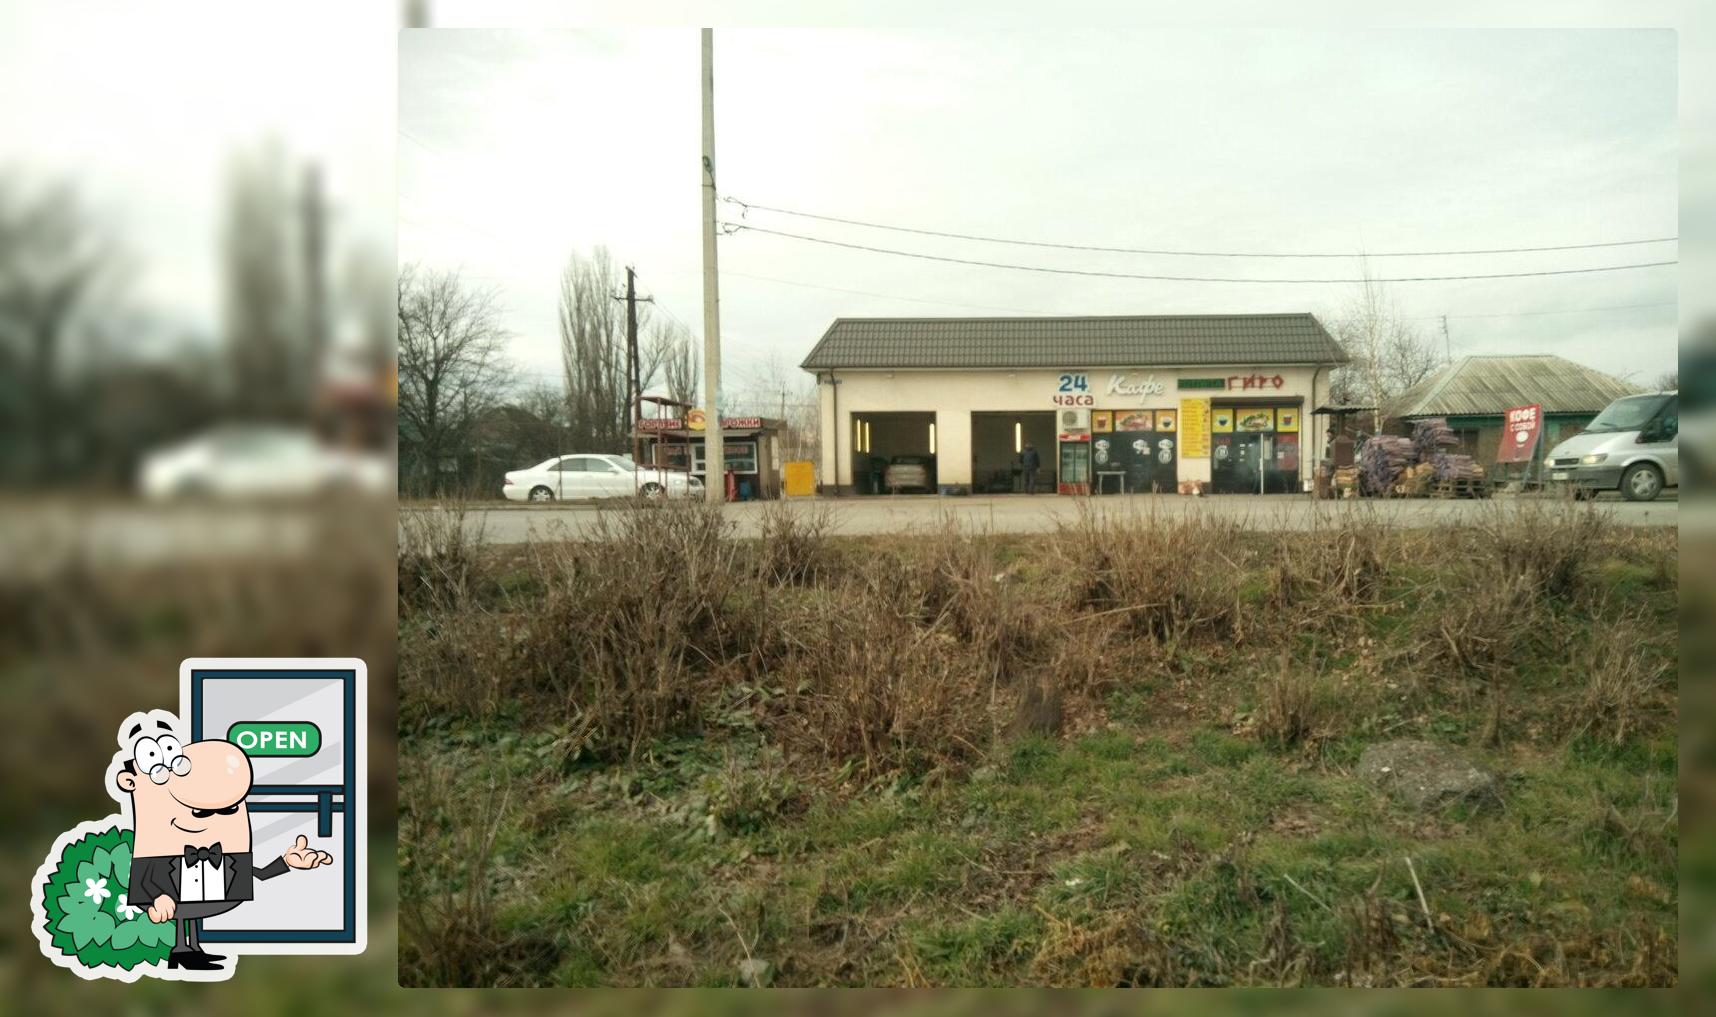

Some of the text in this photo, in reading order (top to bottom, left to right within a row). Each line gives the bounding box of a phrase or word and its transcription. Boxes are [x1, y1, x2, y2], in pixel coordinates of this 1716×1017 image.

[1058, 374, 1088, 392] 24
[1107, 373, 1165, 404] Кафе
[1053, 395, 1094, 406] часа
